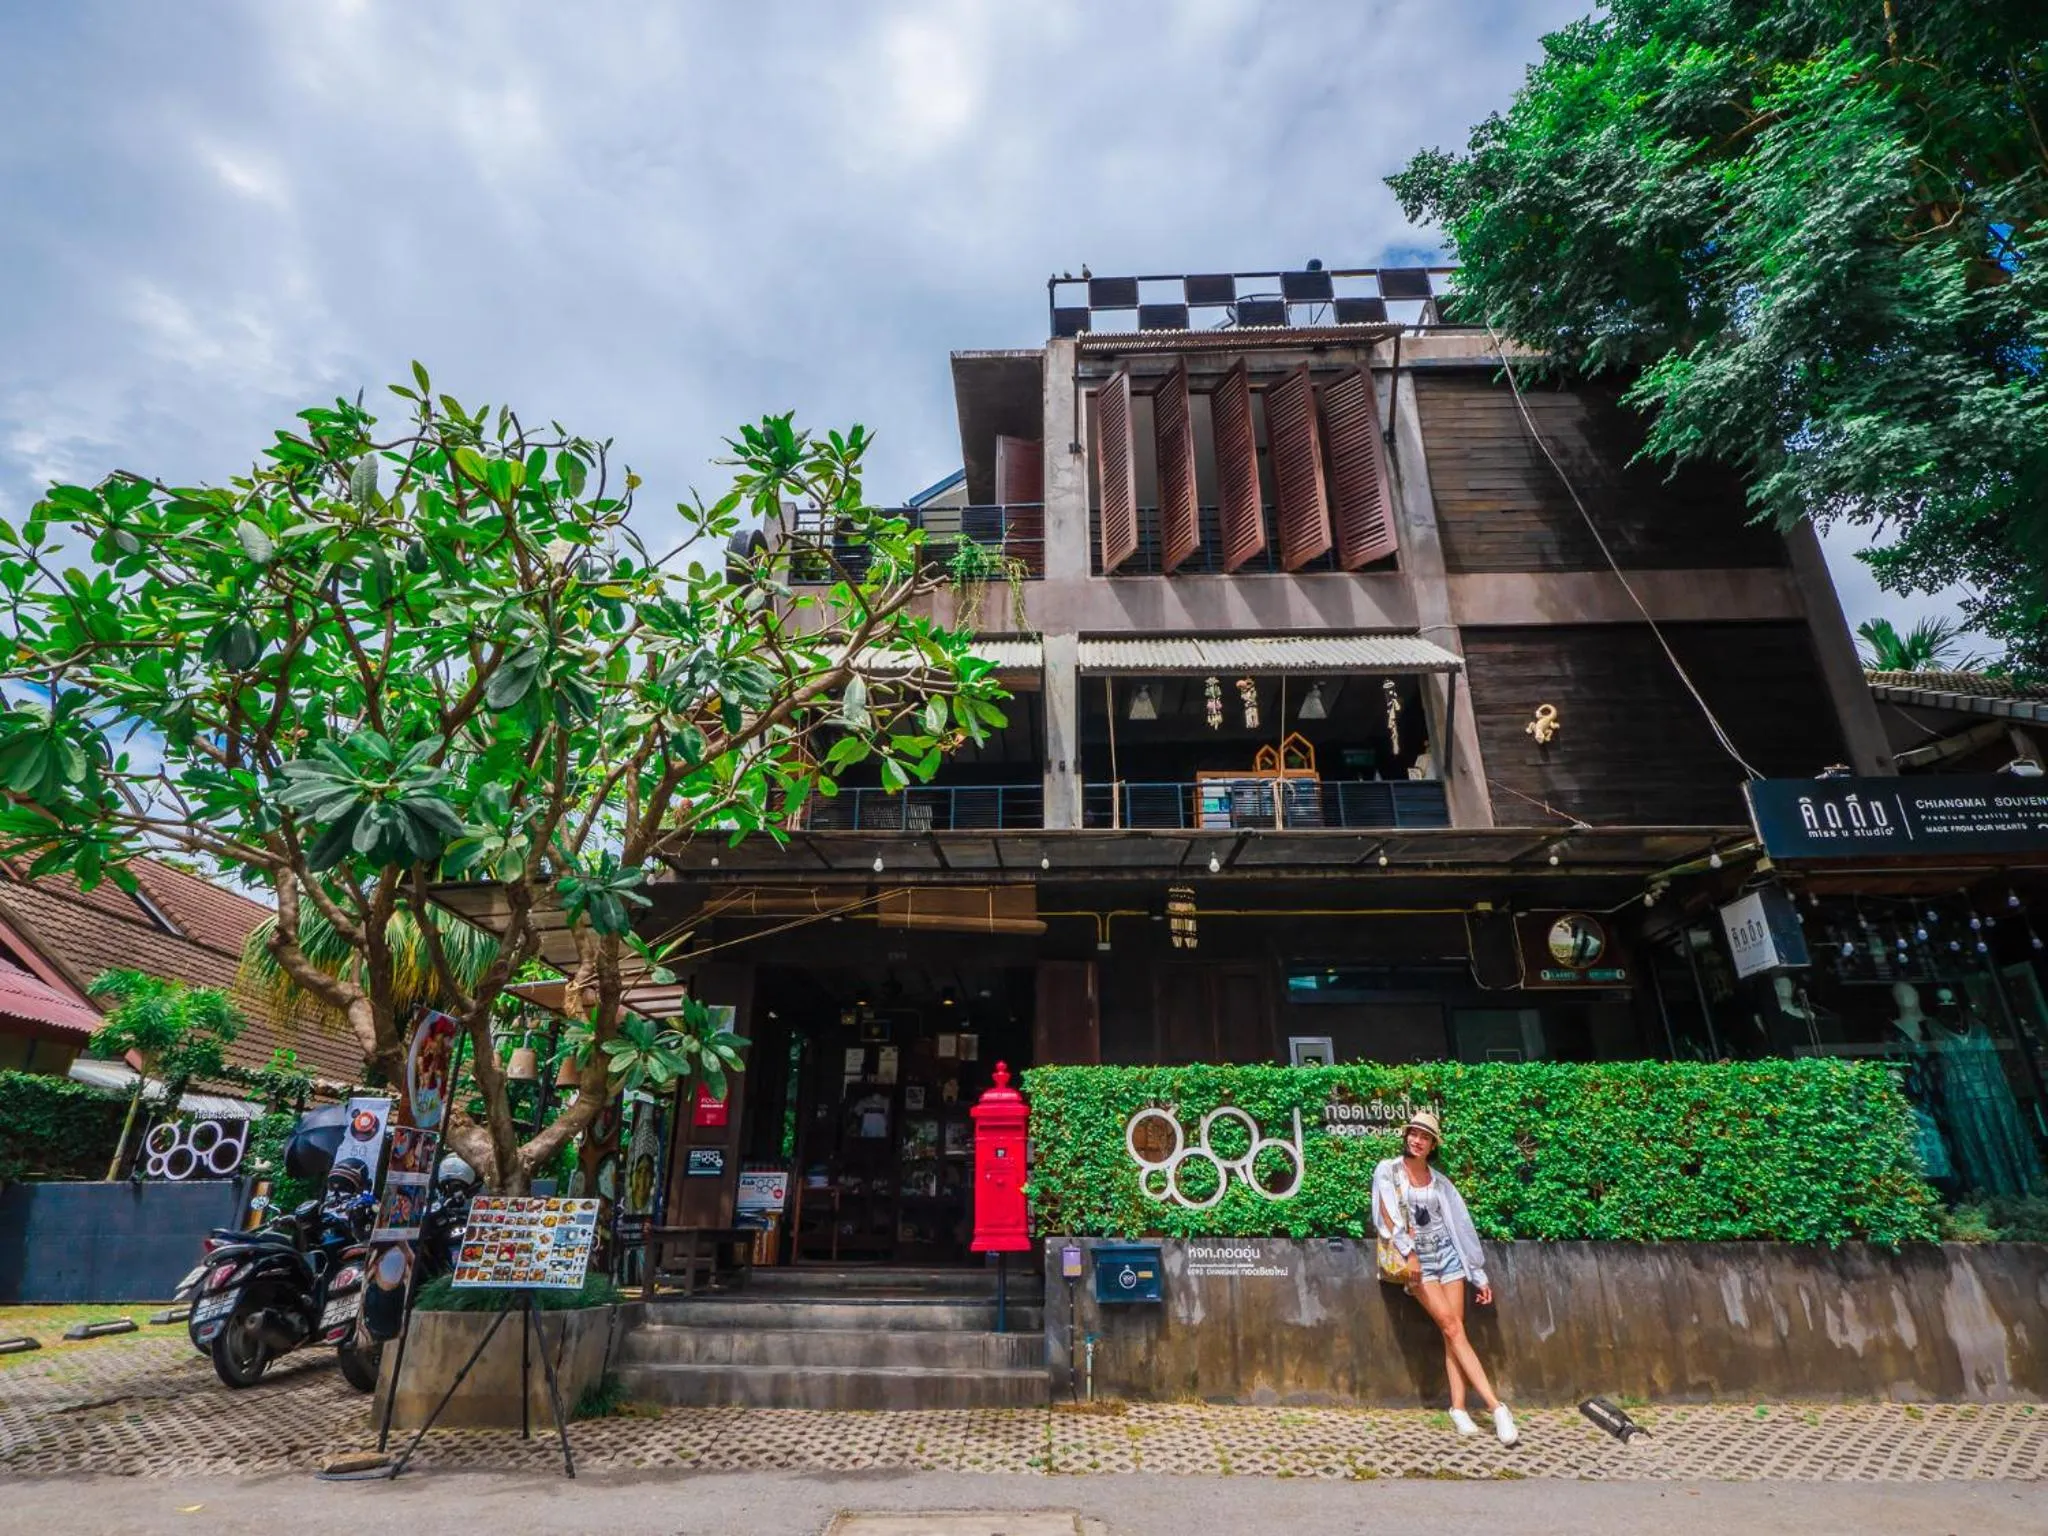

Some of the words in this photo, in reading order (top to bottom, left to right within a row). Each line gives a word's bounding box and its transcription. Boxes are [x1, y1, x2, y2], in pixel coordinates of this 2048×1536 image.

[1916, 798, 1987, 809] CHIANGMAI
[1926, 825, 1949, 833] MADE
[1950, 825, 1974, 833] FROM
[1994, 823, 2028, 831] HEARTS
[1808, 829, 1837, 838] miss
